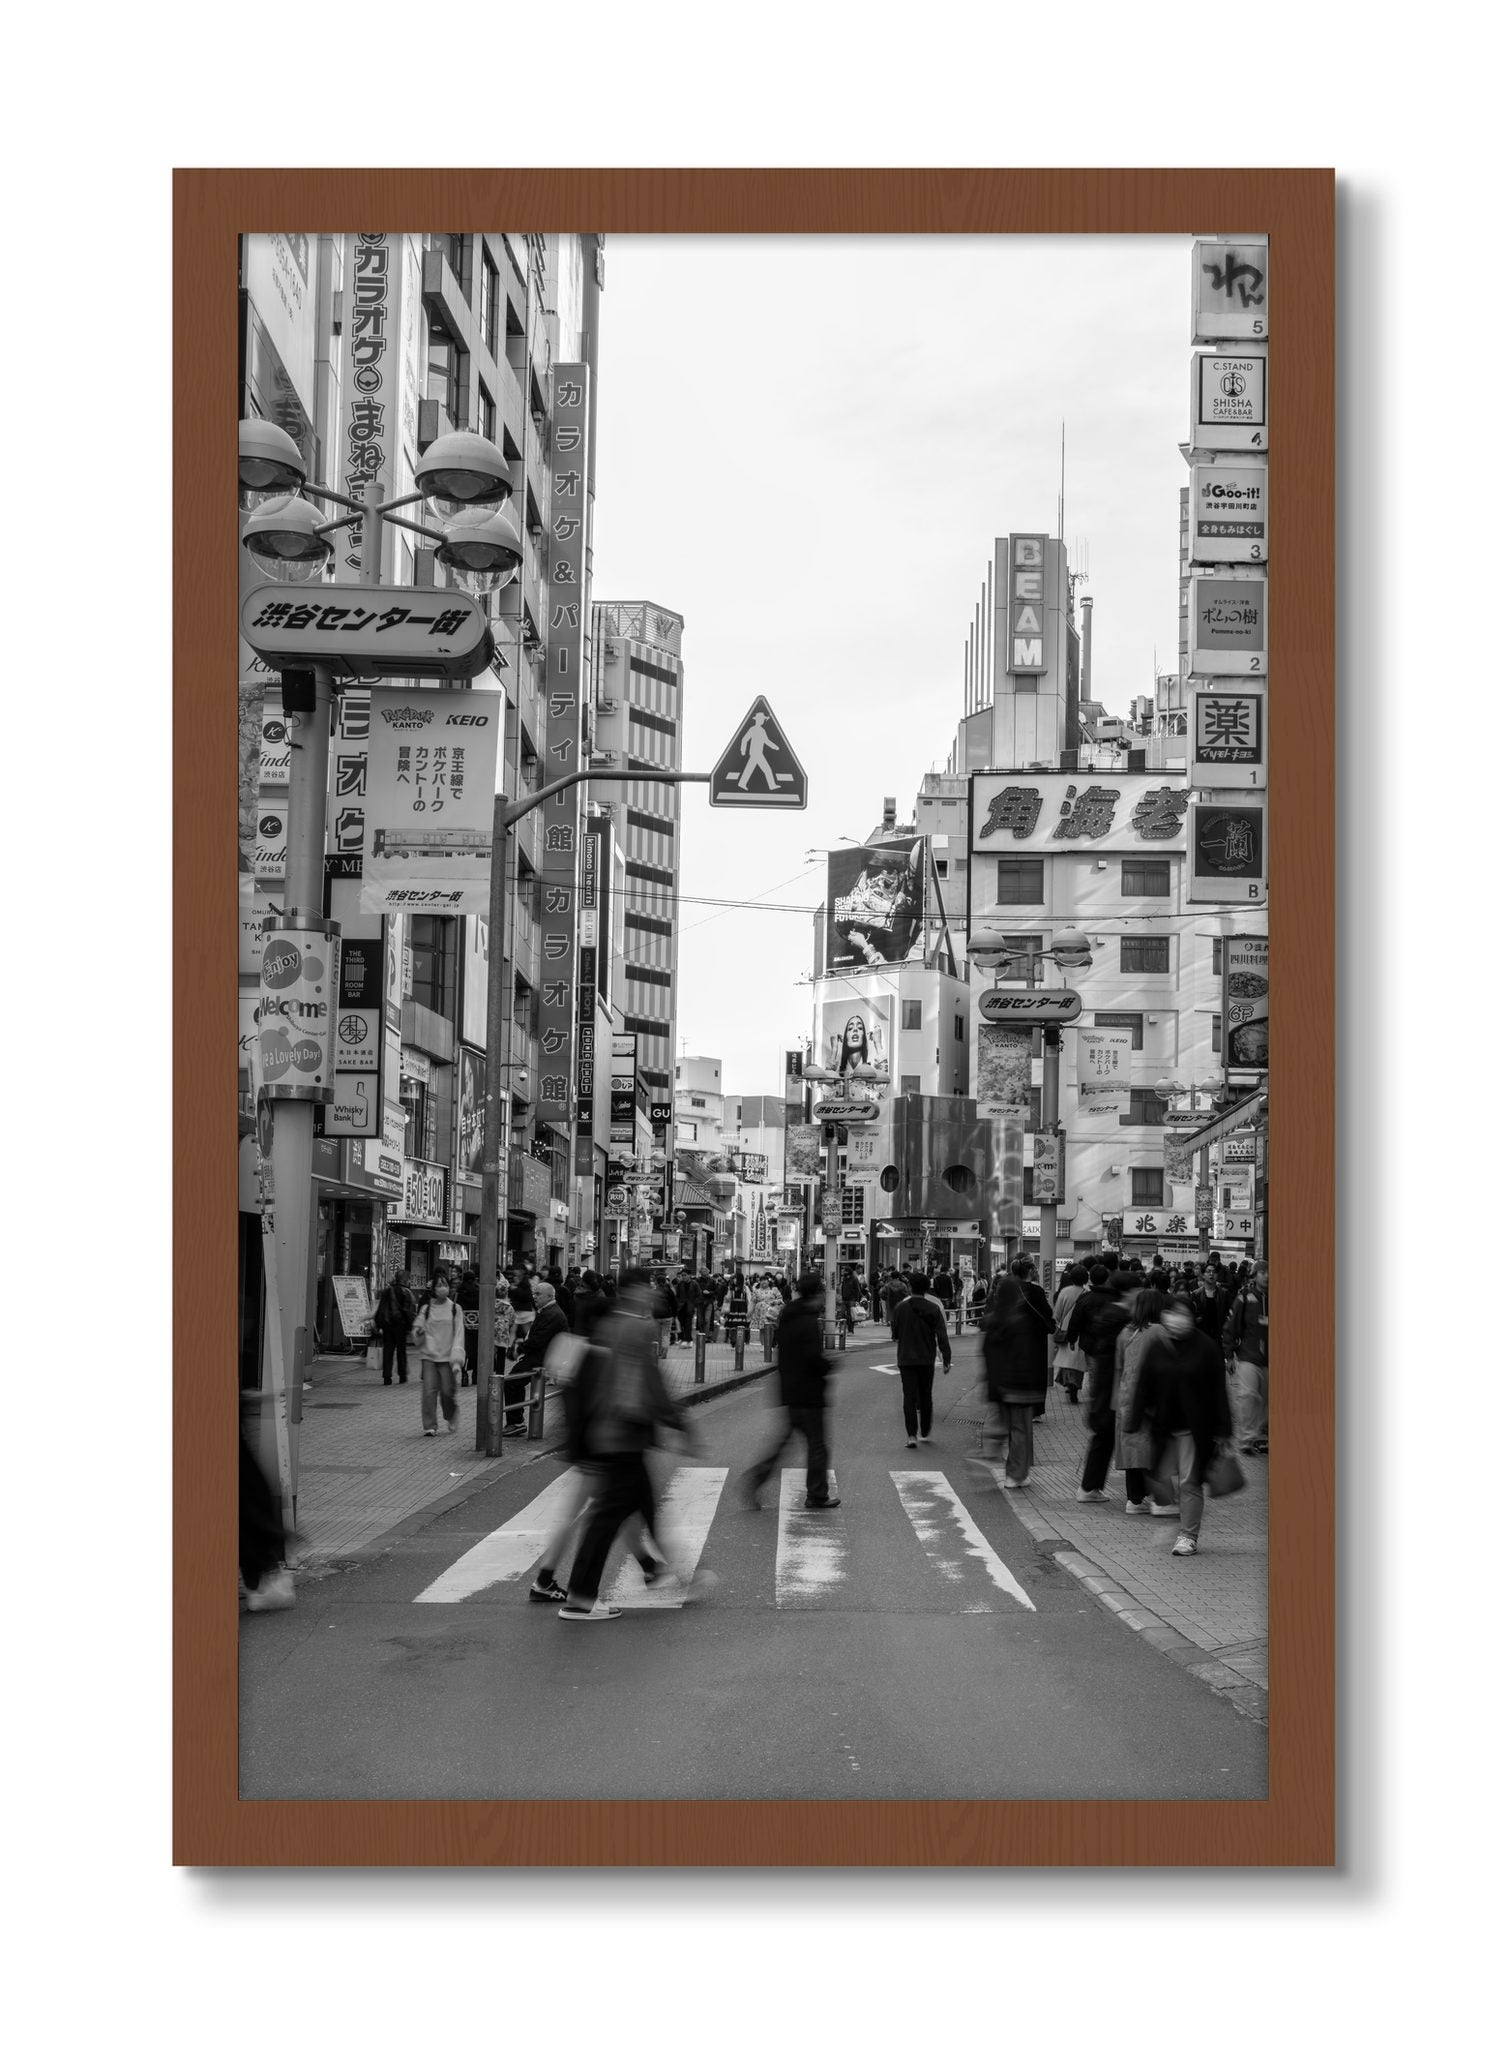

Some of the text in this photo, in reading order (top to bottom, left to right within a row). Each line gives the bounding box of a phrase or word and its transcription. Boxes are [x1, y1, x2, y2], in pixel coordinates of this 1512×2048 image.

[1253, 320, 1264, 335] 5
[1213, 362, 1254, 371] C.STAND
[1213, 398, 1253, 408] SHISHA
[1201, 524, 1261, 535] 全身もみほぐし
[1250, 544, 1261, 559] 3
[1014, 538, 1043, 666] BEAM
[252, 602, 472, 636] 渋谷センター街
[1249, 656, 1261, 671] 2
[445, 715, 489, 727] KEIO
[1205, 700, 1250, 746] 薬
[1200, 748, 1255, 761] マツモトキヨシ
[397, 746, 411, 784] 冒険へ
[450, 747, 466, 800] 京王線で
[413, 746, 429, 812] カントーの
[431, 746, 447, 813] ポケパーク
[1249, 770, 1257, 785] 1
[979, 786, 1189, 840] 角海老
[584, 838, 595, 905] kimono hearts
[385, 889, 465, 902] 渋谷センター街
[1248, 883, 1259, 899] B
[263, 951, 299, 983] Enjoy
[540, 888, 573, 1103] カラオケ館
[985, 997, 1076, 1009] 渋谷センター街
[259, 996, 328, 1018] Welcome
[1228, 1005, 1255, 1023] 6F
[274, 1047, 302, 1065] Lovely
[303, 1048, 321, 1062] Day!
[334, 1105, 364, 1116] Whisky
[652, 1108, 671, 1119] GU
